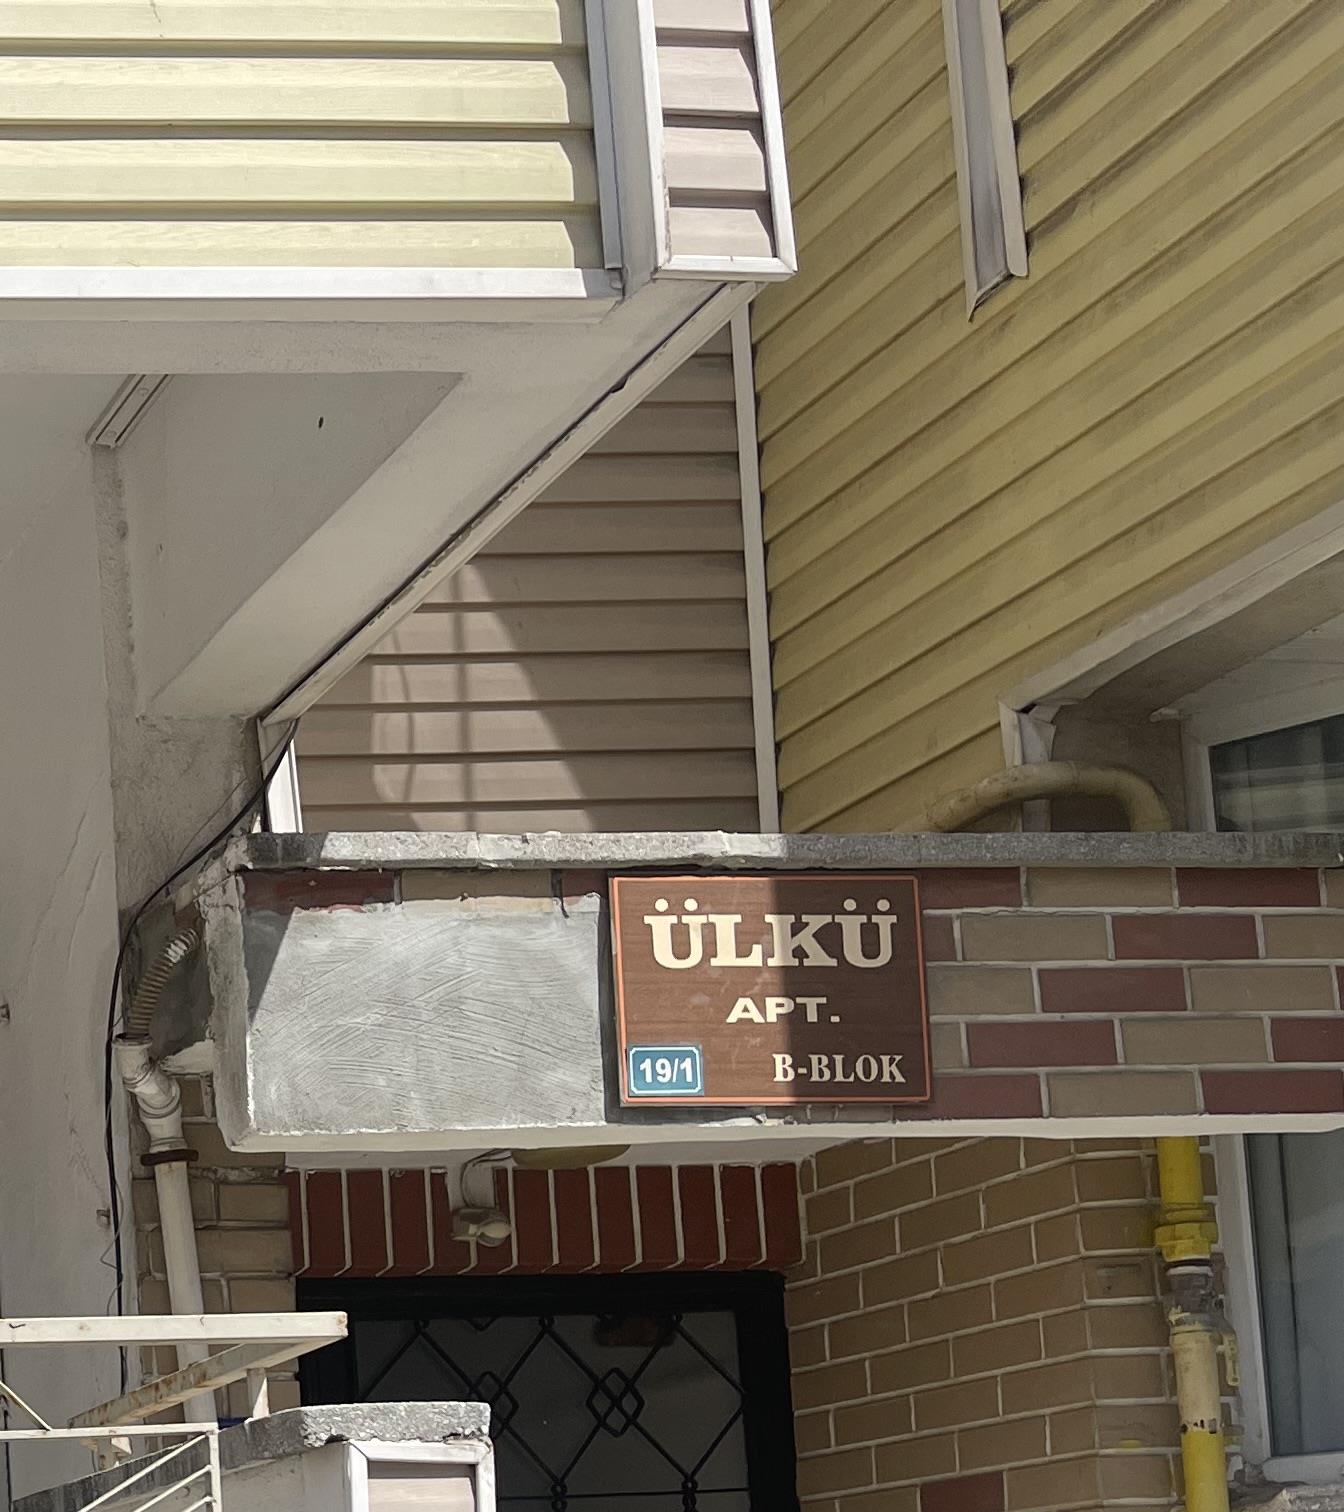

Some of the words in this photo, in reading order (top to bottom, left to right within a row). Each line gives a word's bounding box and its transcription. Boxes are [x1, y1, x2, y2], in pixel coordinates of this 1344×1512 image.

[643, 898, 898, 969] ÜLKÜ
[725, 996, 841, 1024] APT.
[639, 1056, 694, 1084] 19/1
[772, 1053, 906, 1083] B-BLOK
